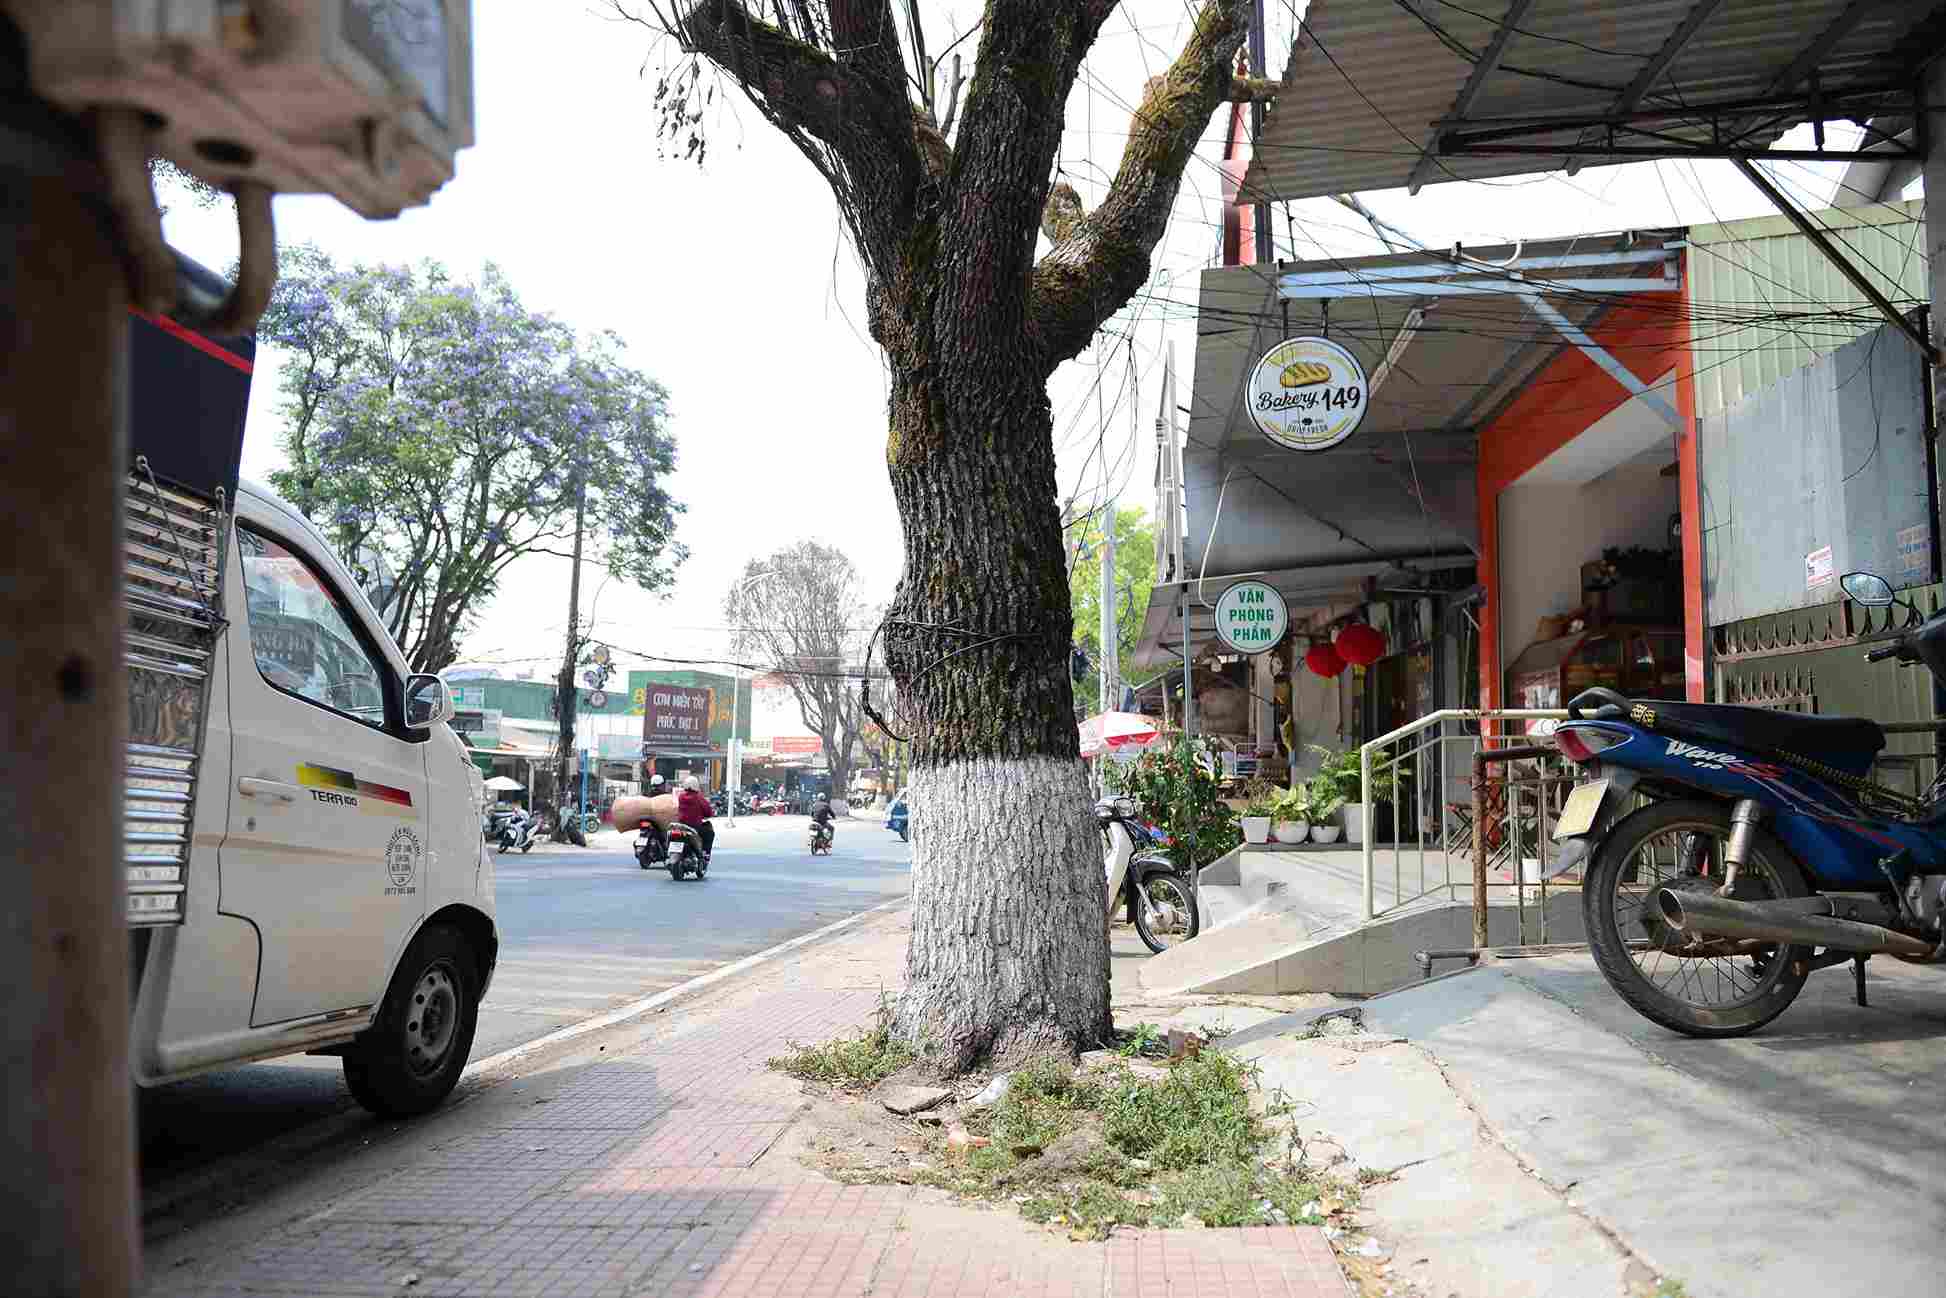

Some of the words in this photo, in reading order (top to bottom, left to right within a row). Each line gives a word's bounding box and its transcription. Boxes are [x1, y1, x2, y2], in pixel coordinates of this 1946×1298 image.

[1256, 391, 1319, 411] Bakery
[1321, 386, 1360, 411] 149
[1230, 606, 1274, 621] PHÒNG
[1664, 736, 1742, 763] Wave
